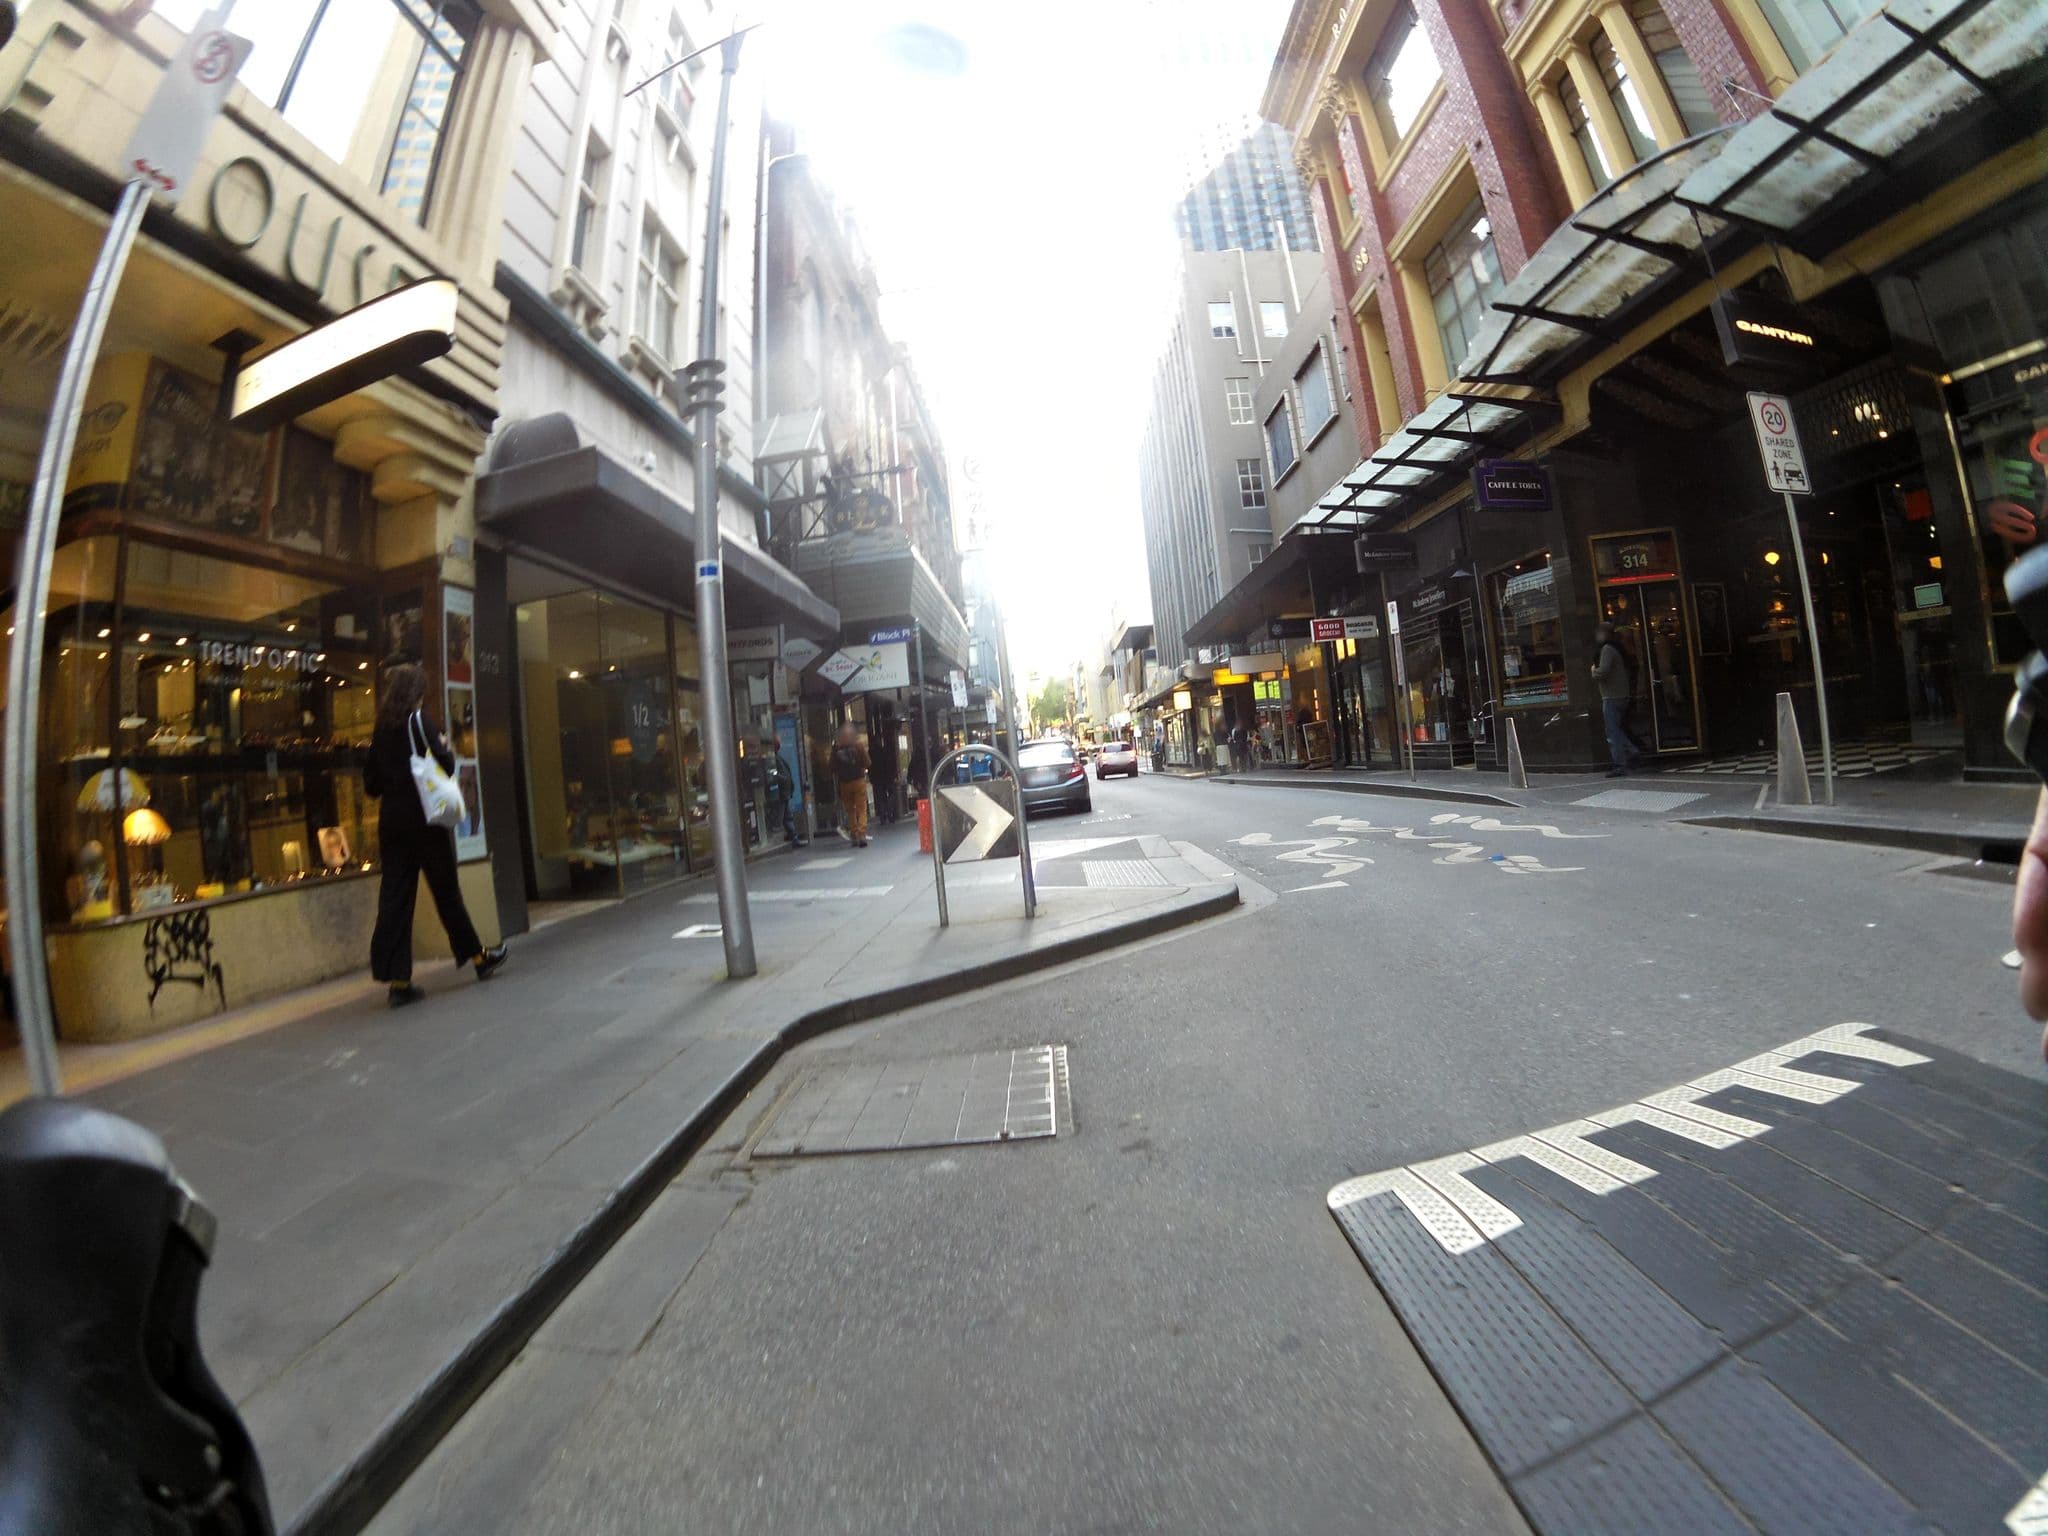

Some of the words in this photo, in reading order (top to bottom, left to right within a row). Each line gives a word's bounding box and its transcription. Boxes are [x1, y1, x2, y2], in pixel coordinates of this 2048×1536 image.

[1735, 319, 1813, 346] CANTURI
[1765, 410, 1782, 426] 20
[1765, 436, 1795, 448] SHARED
[1772, 448, 1792, 459] ZONE
[1623, 553, 1648, 568] 314
